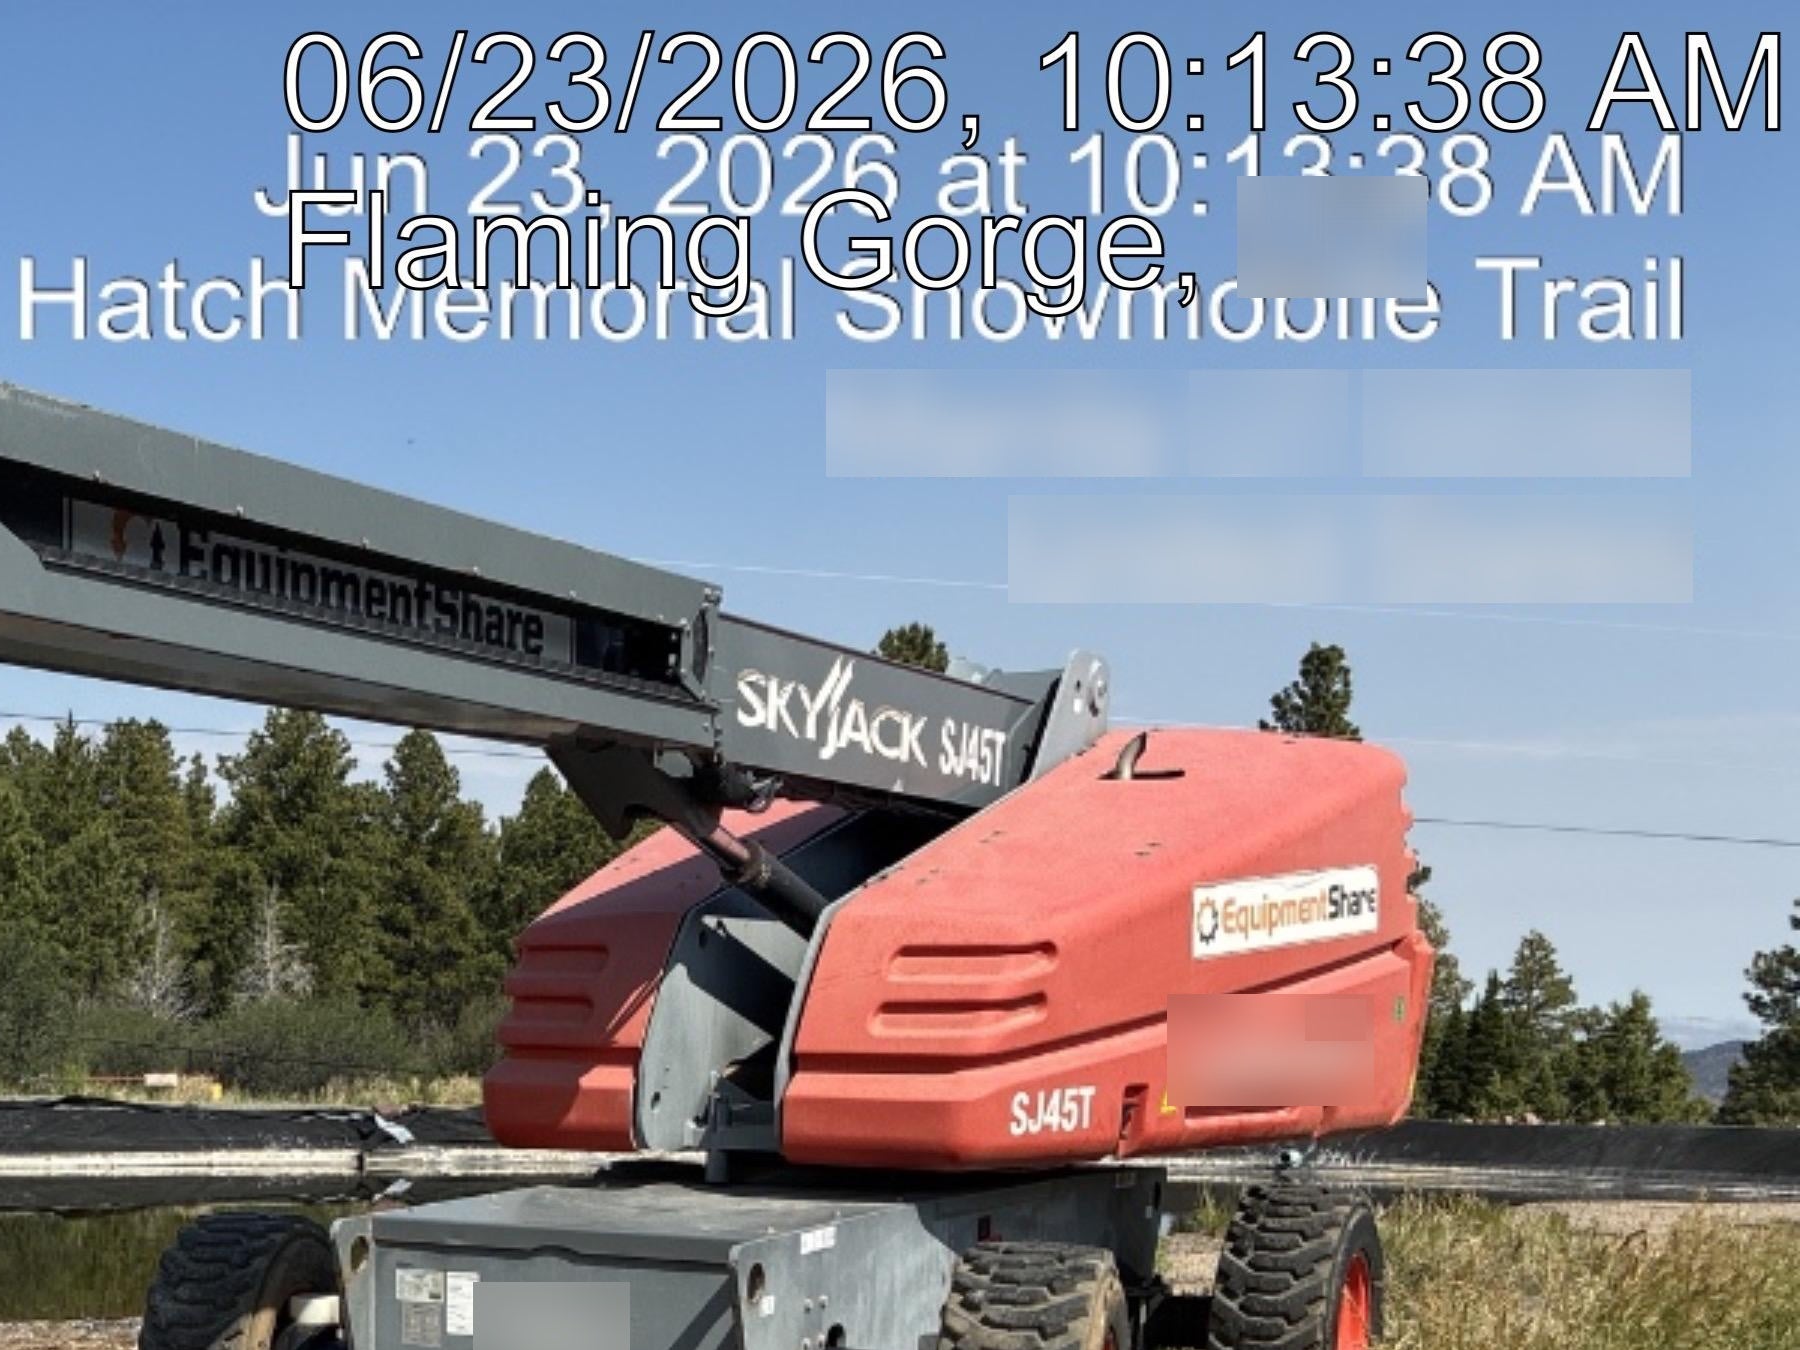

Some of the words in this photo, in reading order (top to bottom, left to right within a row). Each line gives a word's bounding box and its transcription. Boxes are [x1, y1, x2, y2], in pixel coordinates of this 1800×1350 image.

[736, 655, 929, 768] SKYJACK
[938, 718, 1006, 787] SJ45T
[1222, 884, 1376, 940] EquipmentShare
[1010, 1085, 1096, 1136] SJ45T
